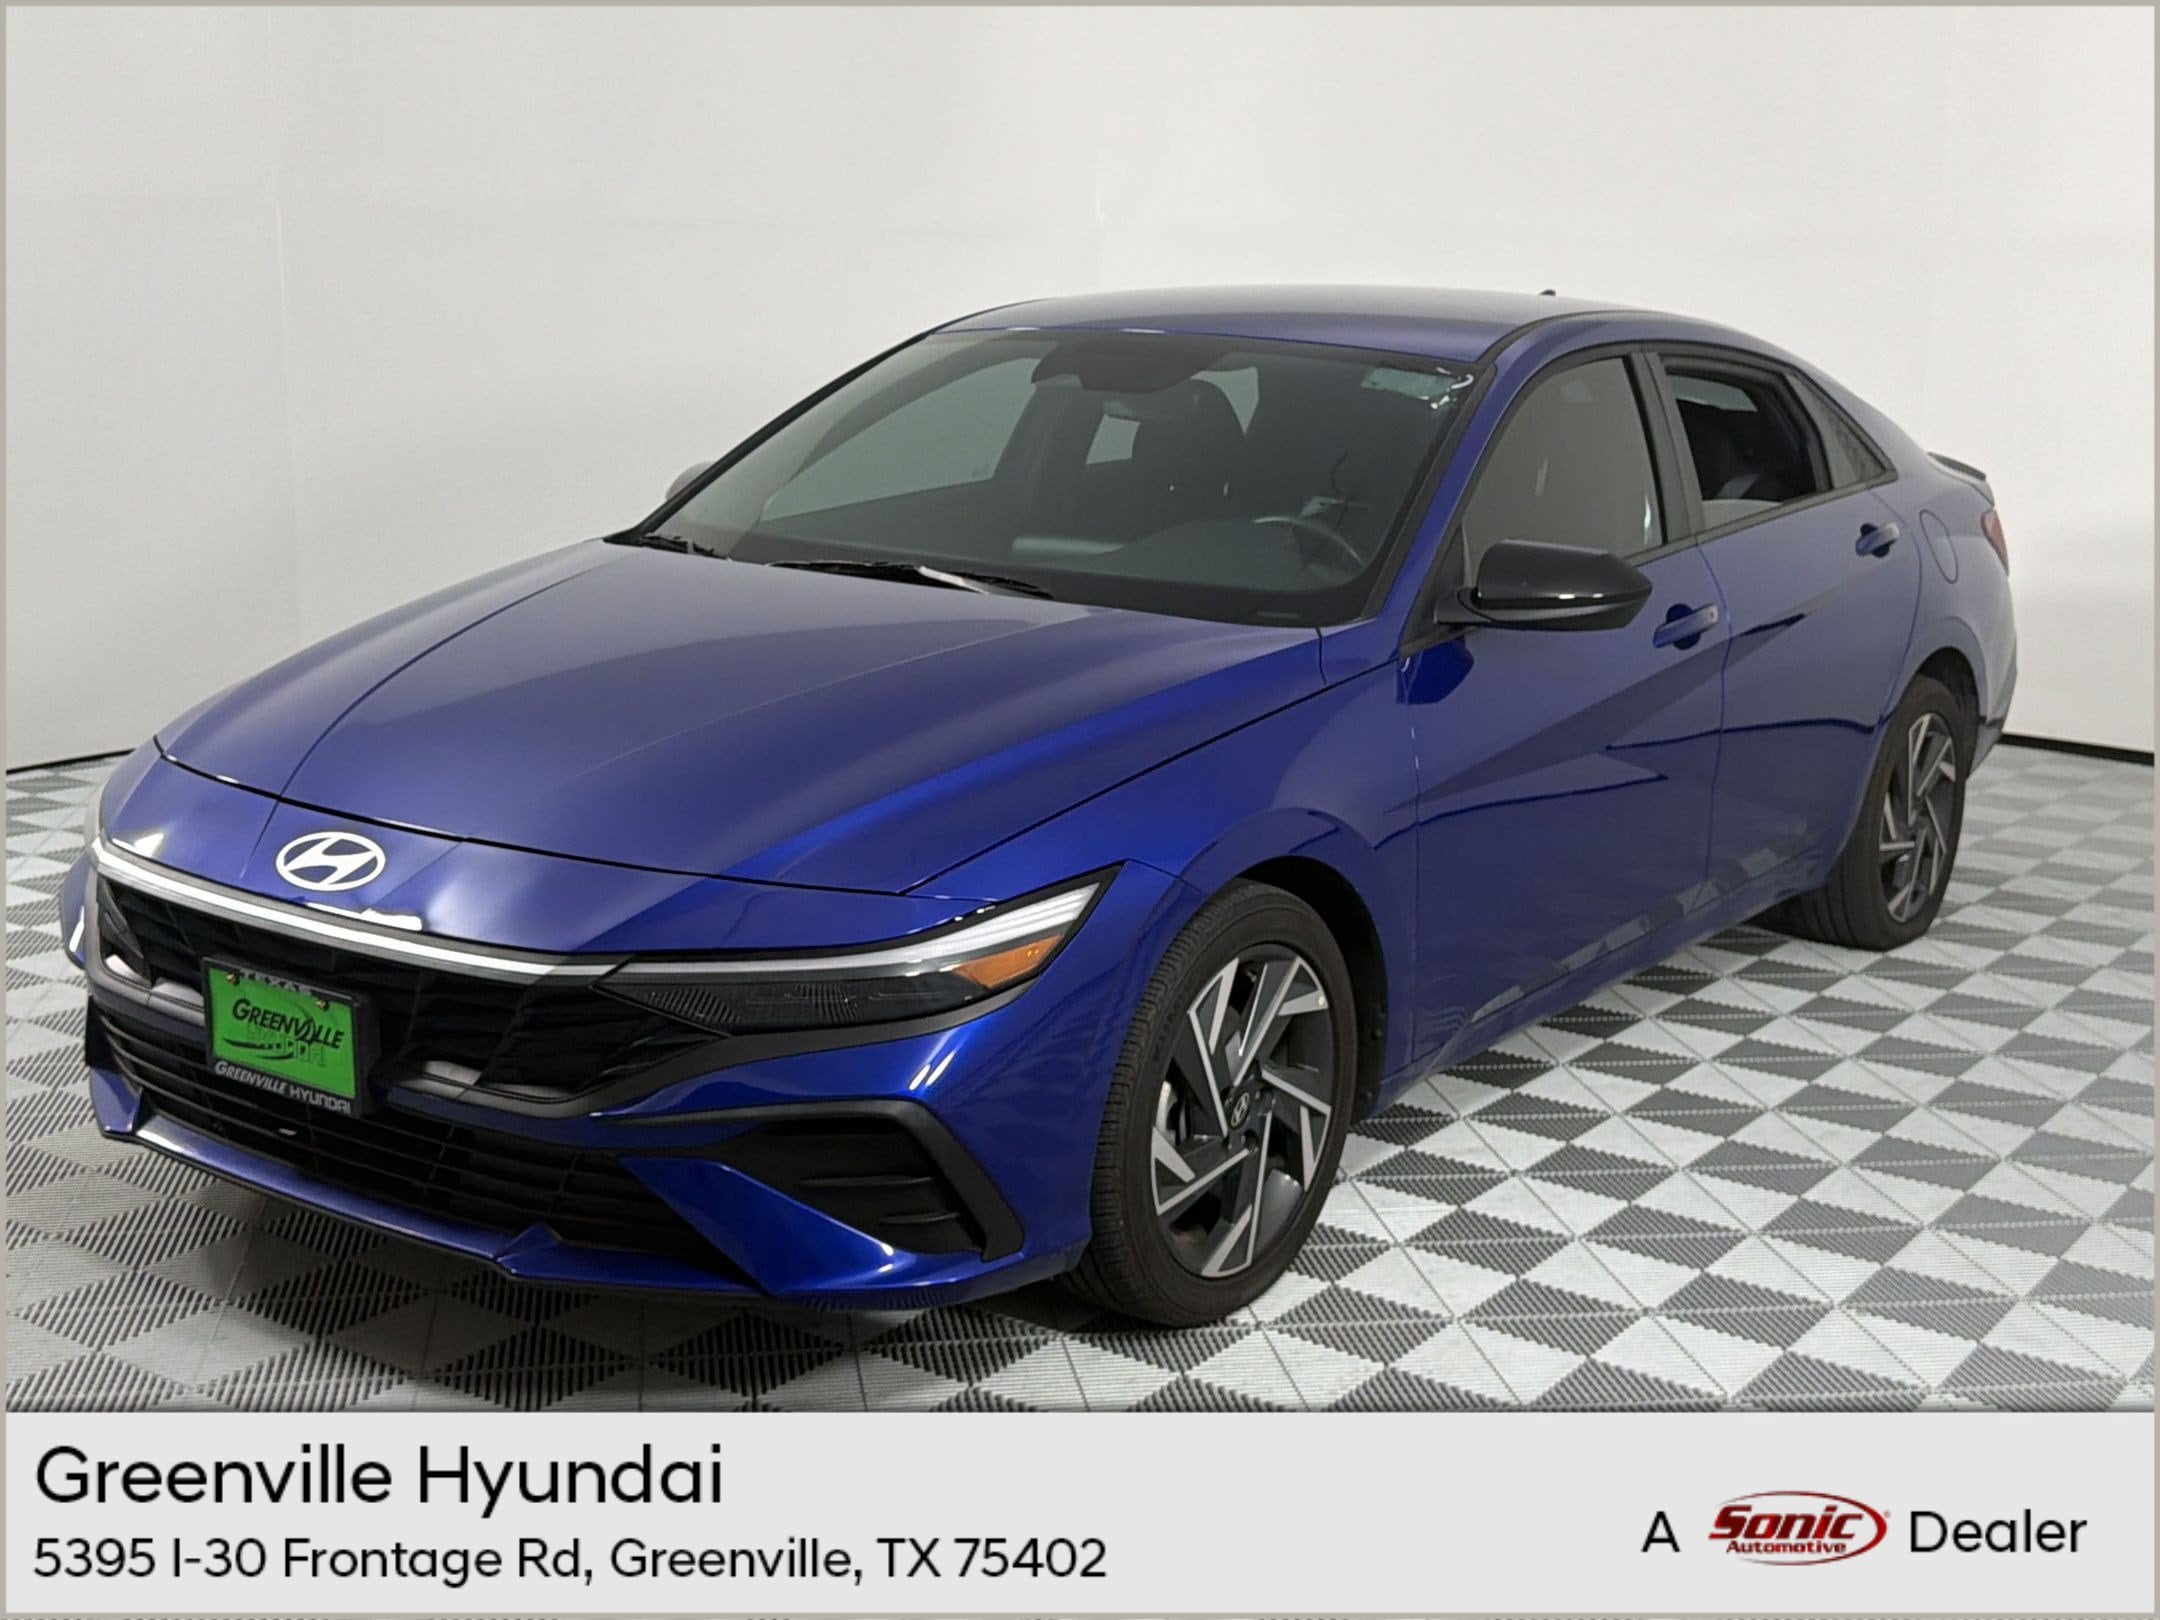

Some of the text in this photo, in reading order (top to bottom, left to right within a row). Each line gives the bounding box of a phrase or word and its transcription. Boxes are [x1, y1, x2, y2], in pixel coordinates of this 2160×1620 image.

[232, 998, 345, 1050] GREENVILLE
[214, 1060, 352, 1115] GREENVILLE HYUNDAI
